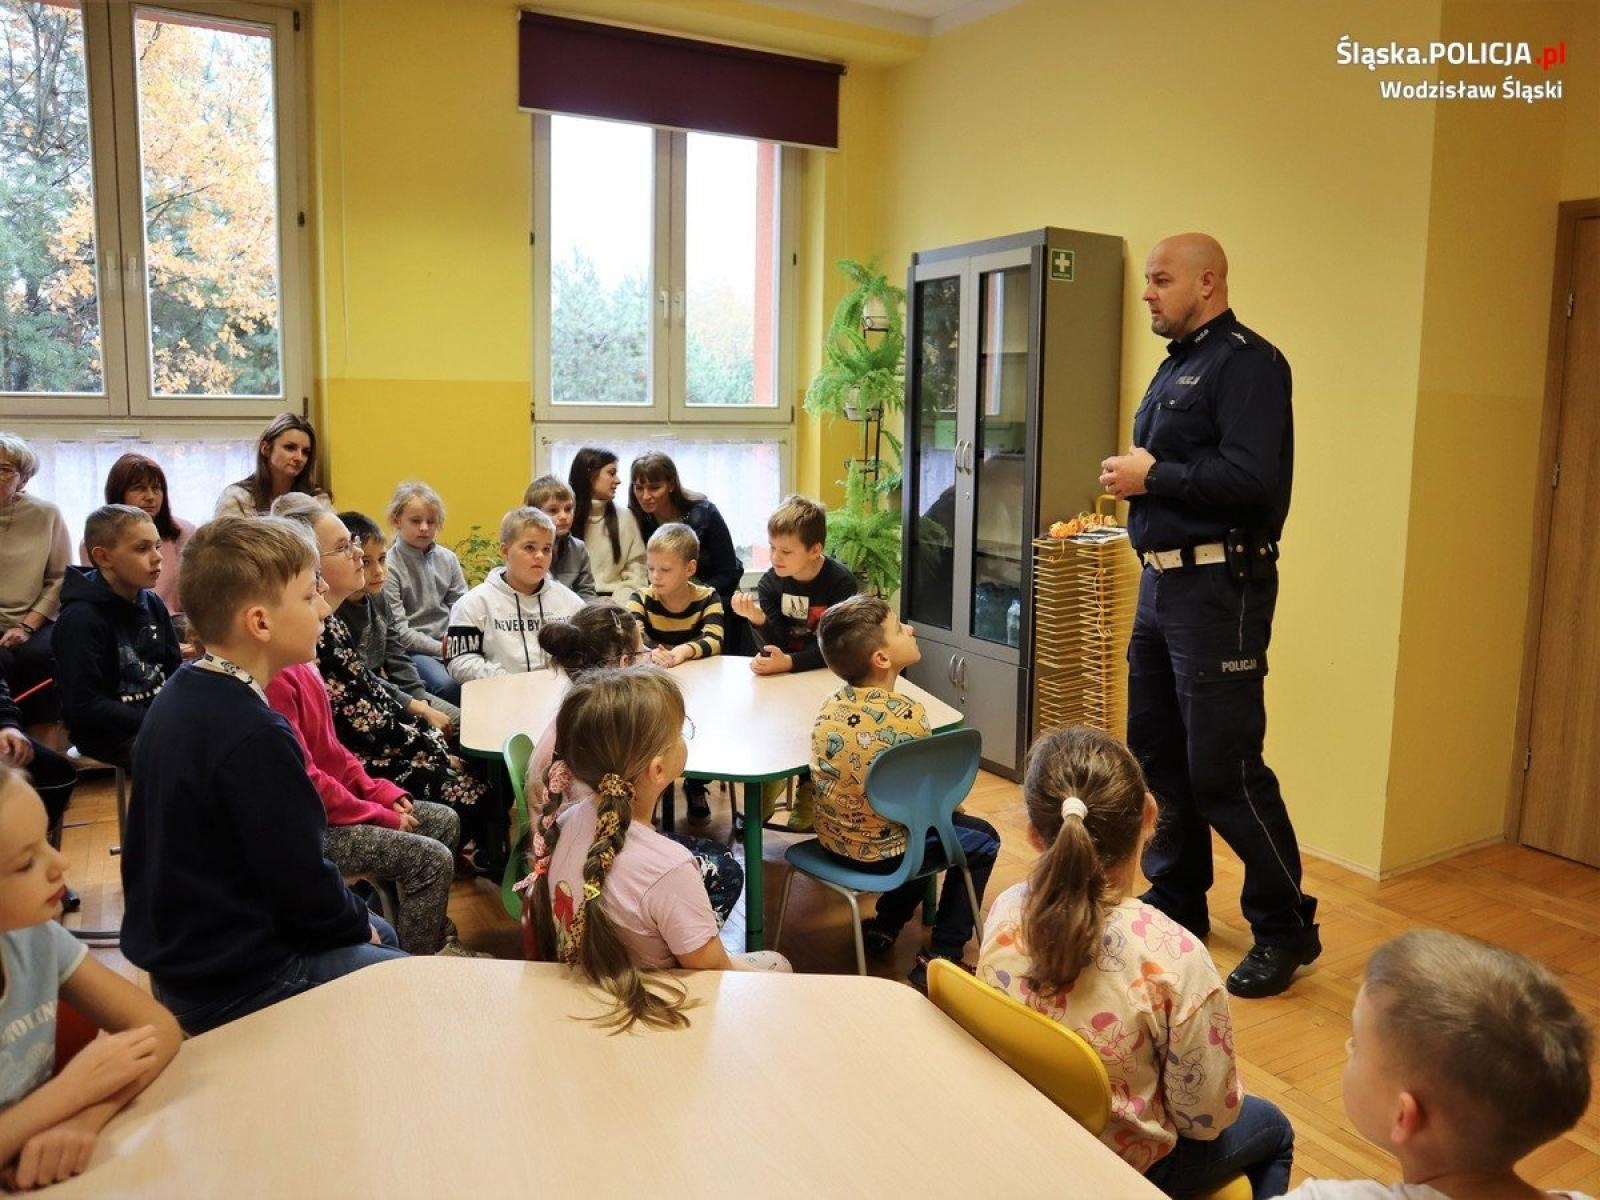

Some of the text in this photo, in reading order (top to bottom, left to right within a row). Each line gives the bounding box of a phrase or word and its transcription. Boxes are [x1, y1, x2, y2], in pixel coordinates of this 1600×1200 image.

[494, 618, 525, 632] NEVER
[527, 619, 541, 632] BY
[1221, 658, 1257, 673] POLICJA
